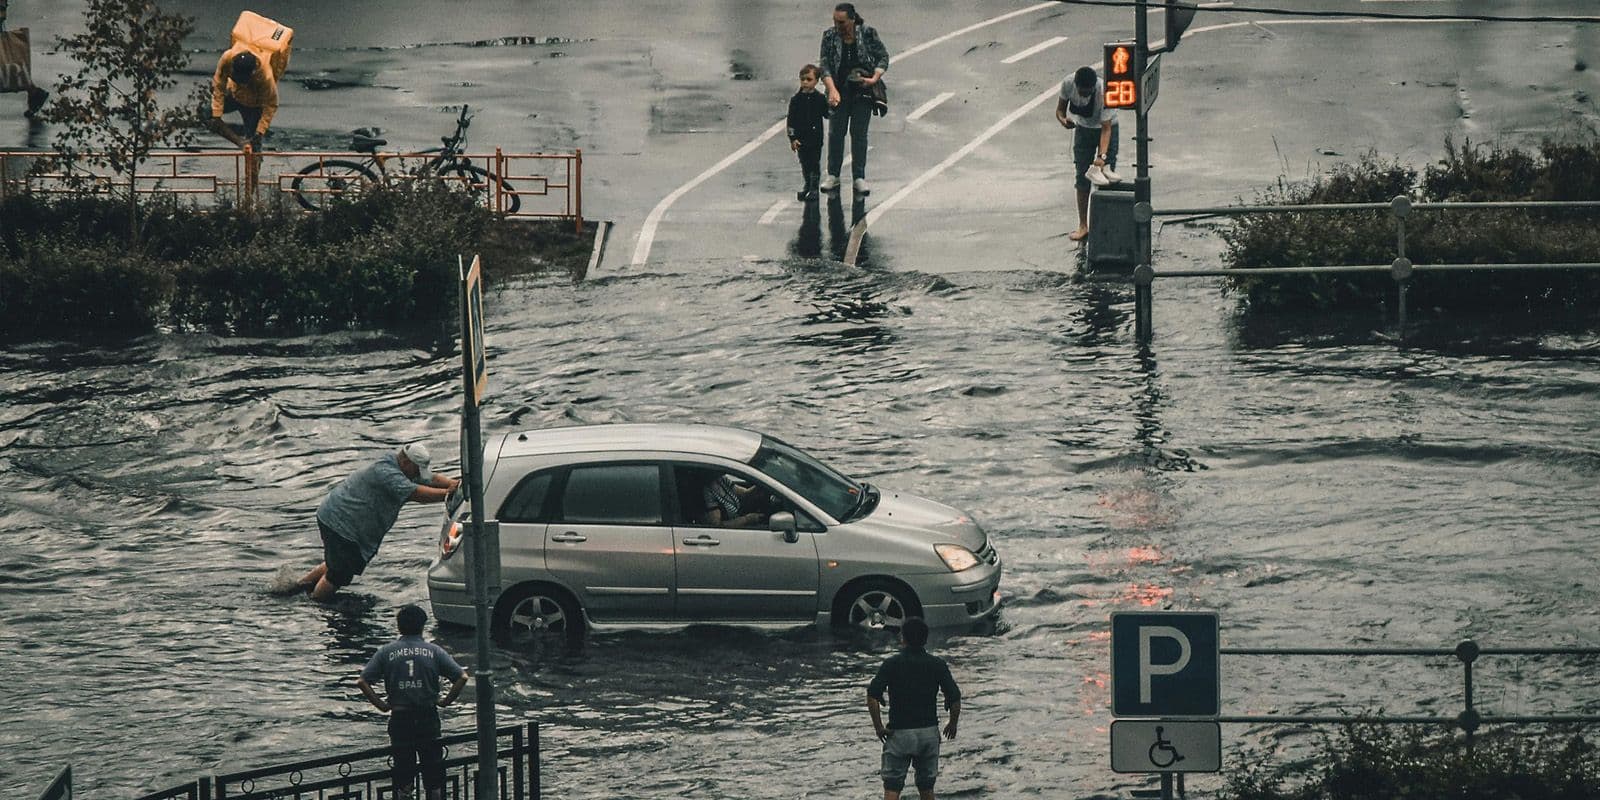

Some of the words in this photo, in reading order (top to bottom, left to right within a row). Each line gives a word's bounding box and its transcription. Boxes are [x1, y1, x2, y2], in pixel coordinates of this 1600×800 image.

[1106, 81, 1135, 106] 28
[389, 647, 434, 660] DIMENSION
[405, 659, 415, 677] 1
[1139, 626, 1192, 704] P
[399, 680, 423, 689] SPAS
